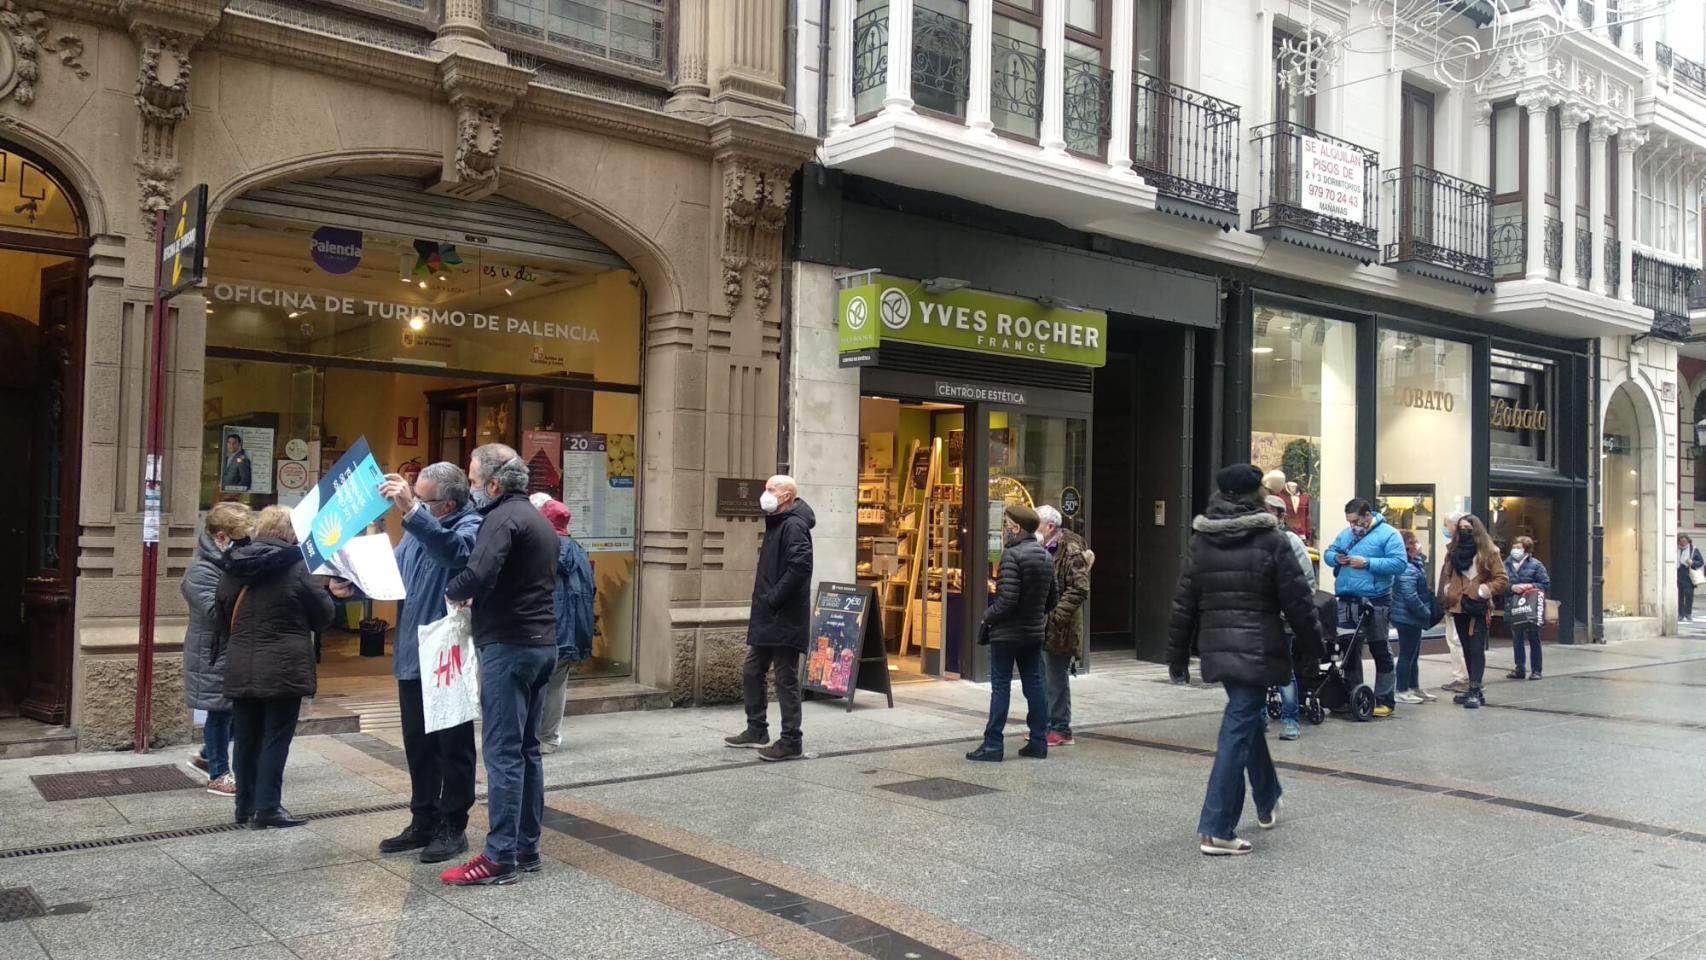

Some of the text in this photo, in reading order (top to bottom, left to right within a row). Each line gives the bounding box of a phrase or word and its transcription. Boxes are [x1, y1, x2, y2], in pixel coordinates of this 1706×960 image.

[1305, 140, 1361, 166] SE ALQUILAN
[1313, 158, 1354, 180] PISOS DE
[1305, 170, 1361, 193] 2 Y 3 DORMITORIOS
[1309, 184, 1358, 207] 979 70 24 43
[1320, 202, 1347, 215] MAÑANAS
[311, 239, 361, 257] Palencia
[214, 283, 601, 343] OFICINA DE TURISMO DE PALENCIA
[919, 301, 1099, 348] YVES ROCHER
[977, 335, 1047, 354] FRANCE
[939, 385, 1025, 404] CENTRO DE ESTÉTICA
[570, 439, 588, 450] 20
